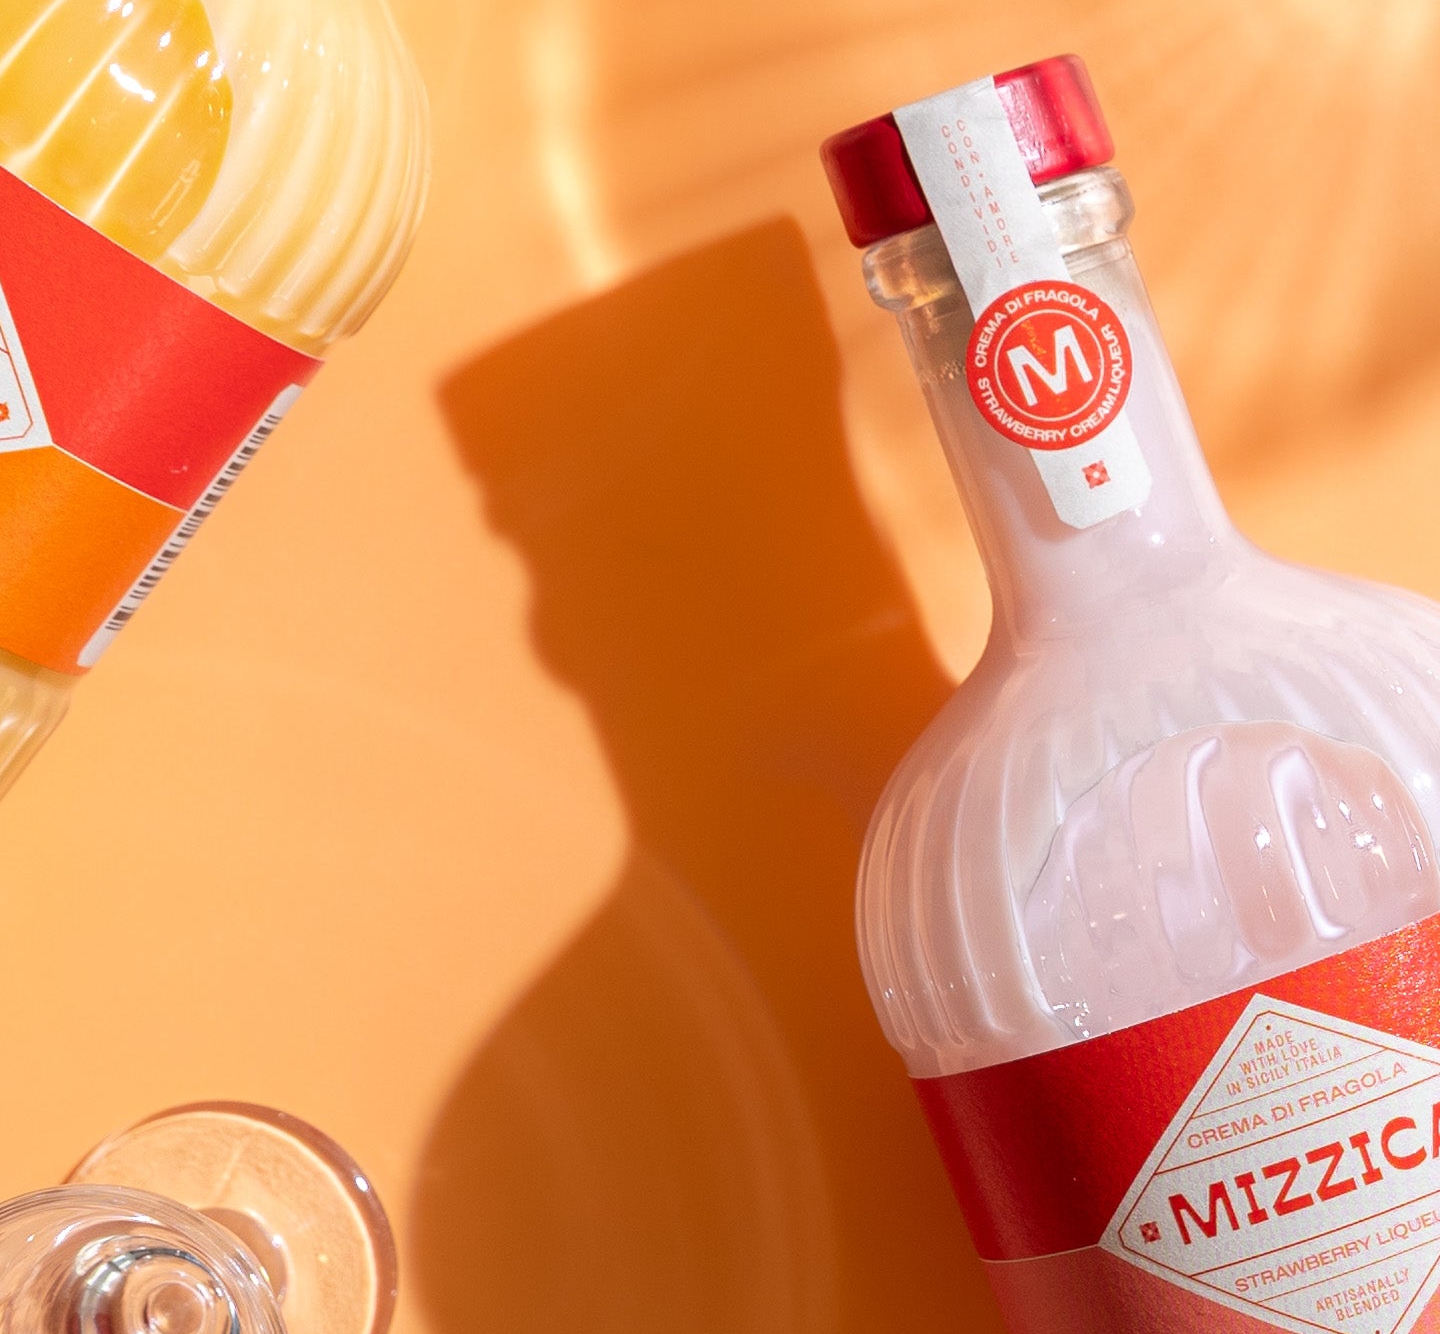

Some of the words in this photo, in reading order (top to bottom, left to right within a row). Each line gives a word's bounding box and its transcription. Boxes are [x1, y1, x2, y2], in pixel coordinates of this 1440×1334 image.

[941, 125, 1002, 268] CONDIVIDI
[975, 312, 1007, 367] CREMA
[1005, 297, 1023, 314] DI
[1024, 290, 1099, 321] FRAGOLA
[978, 377, 1069, 442] STRAWBERRY
[1070, 394, 1117, 438] CREAM
[1100, 324, 1125, 394] LIQUEUR
[1006, 324, 1093, 407] M
[1226, 1083, 1241, 1096] IN
[1246, 1065, 1290, 1090] SICILY
[1296, 1045, 1342, 1072] ITALIA
[1240, 1053, 1276, 1076] WITH
[1283, 1038, 1318, 1061] LOVE
[1254, 1031, 1294, 1055] MADE
[1187, 1113, 1267, 1149] CREMA
[1271, 1101, 1294, 1122] DI
[1298, 1061, 1407, 1113] FRAGOLA
[1234, 1235, 1371, 1293] STRAWBERRY
[1316, 1268, 1409, 1313] ARTISANALLY
[1335, 1290, 1400, 1322] BLENDED
